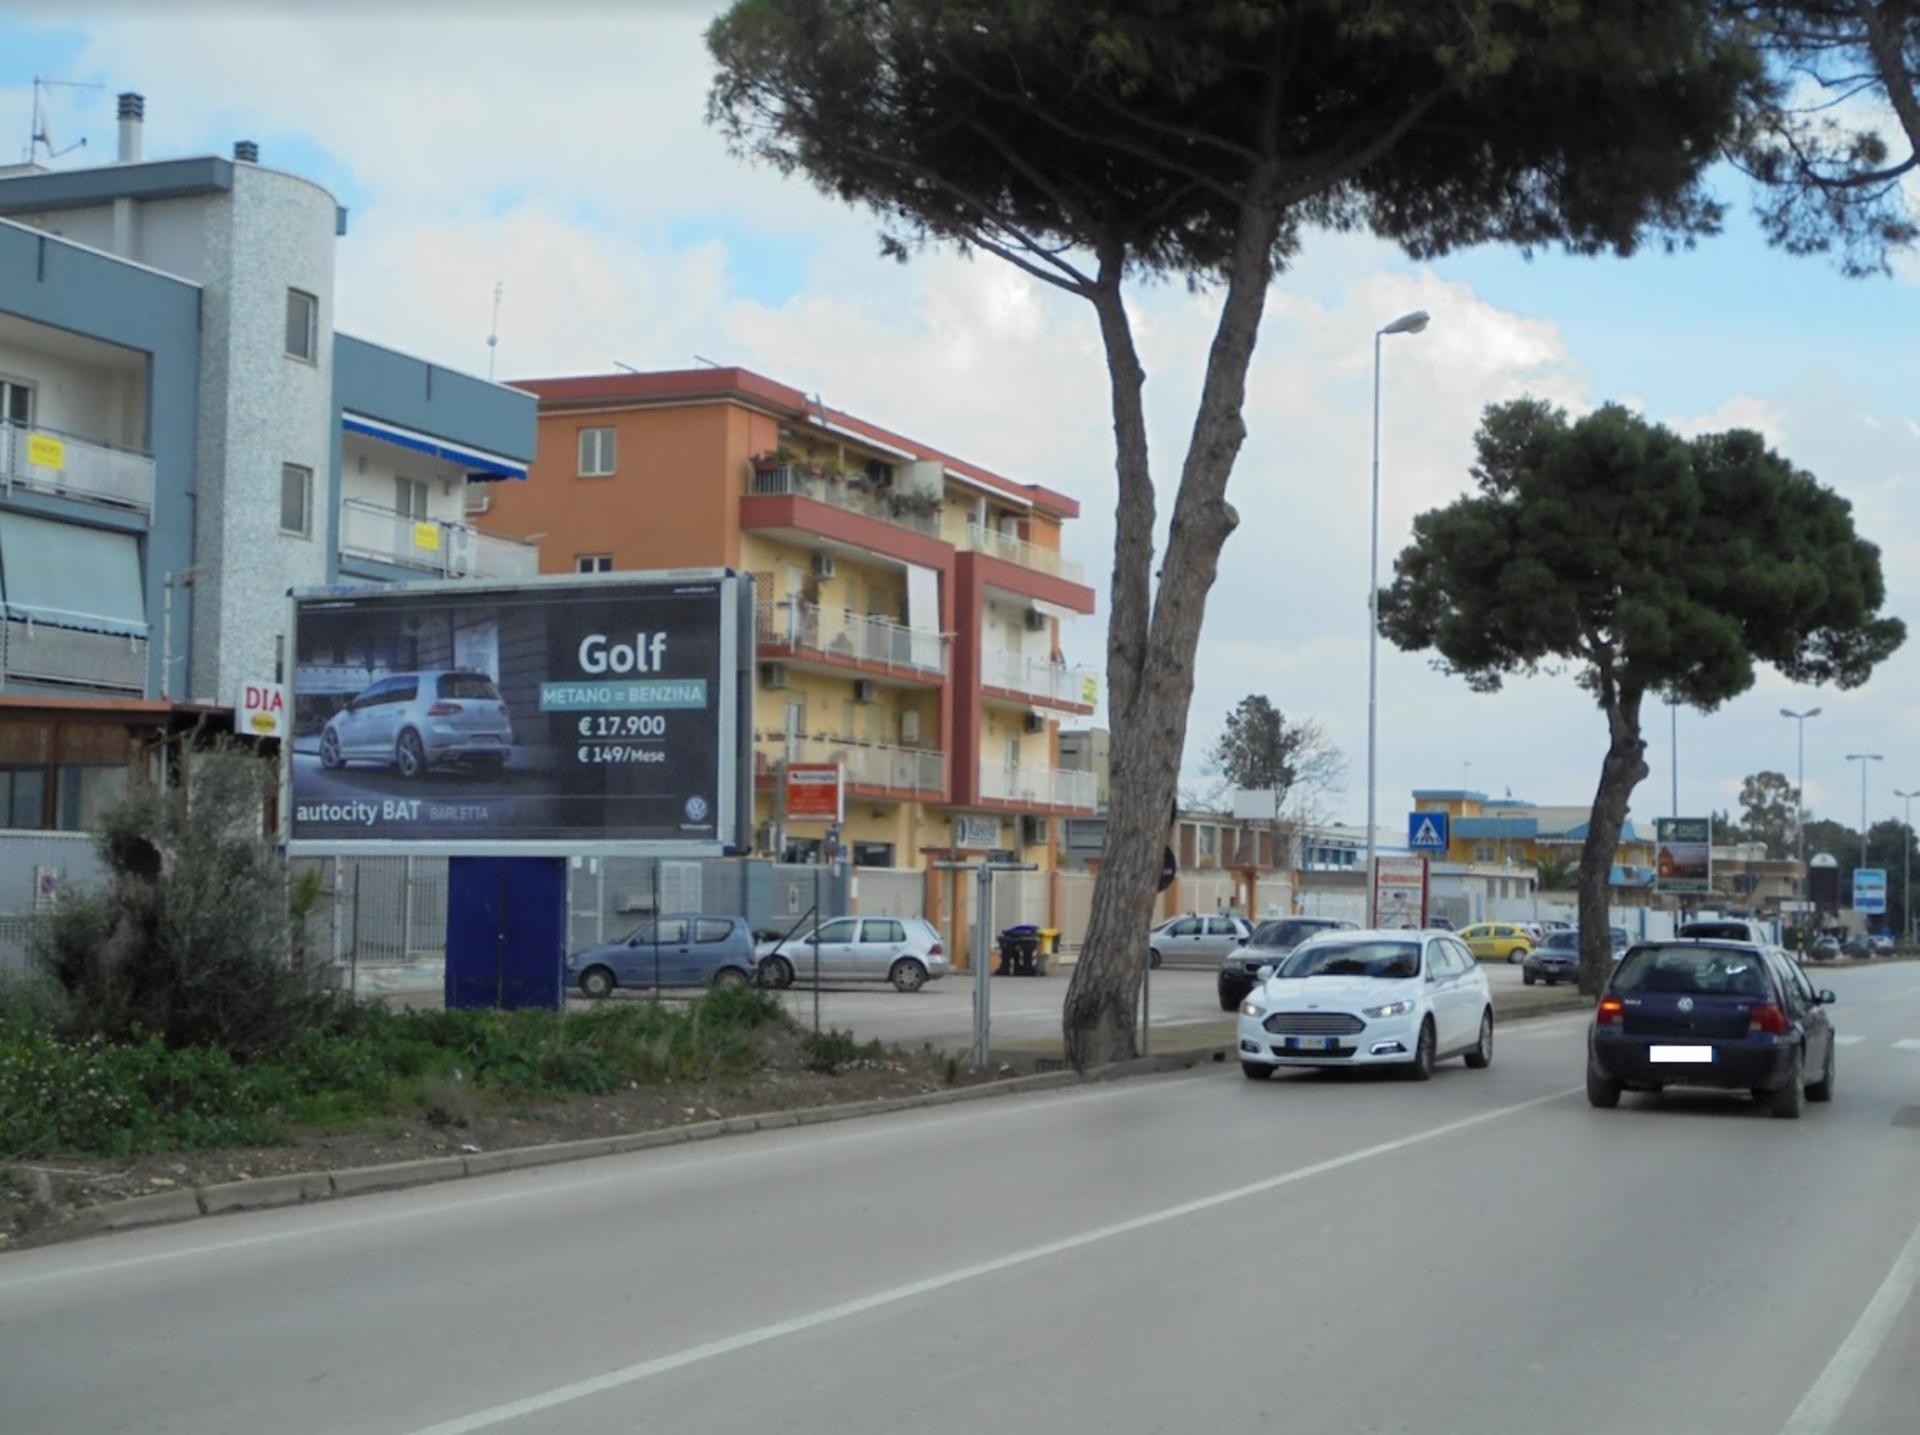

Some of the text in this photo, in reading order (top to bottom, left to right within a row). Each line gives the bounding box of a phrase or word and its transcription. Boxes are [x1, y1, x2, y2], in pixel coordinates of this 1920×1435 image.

[579, 632, 667, 674] Golf
[543, 688, 610, 705] METANO
[629, 683, 701, 702] BENZINA
[597, 716, 666, 736] 17.900
[296, 801, 488, 826] autocity BAT BARLETTA
